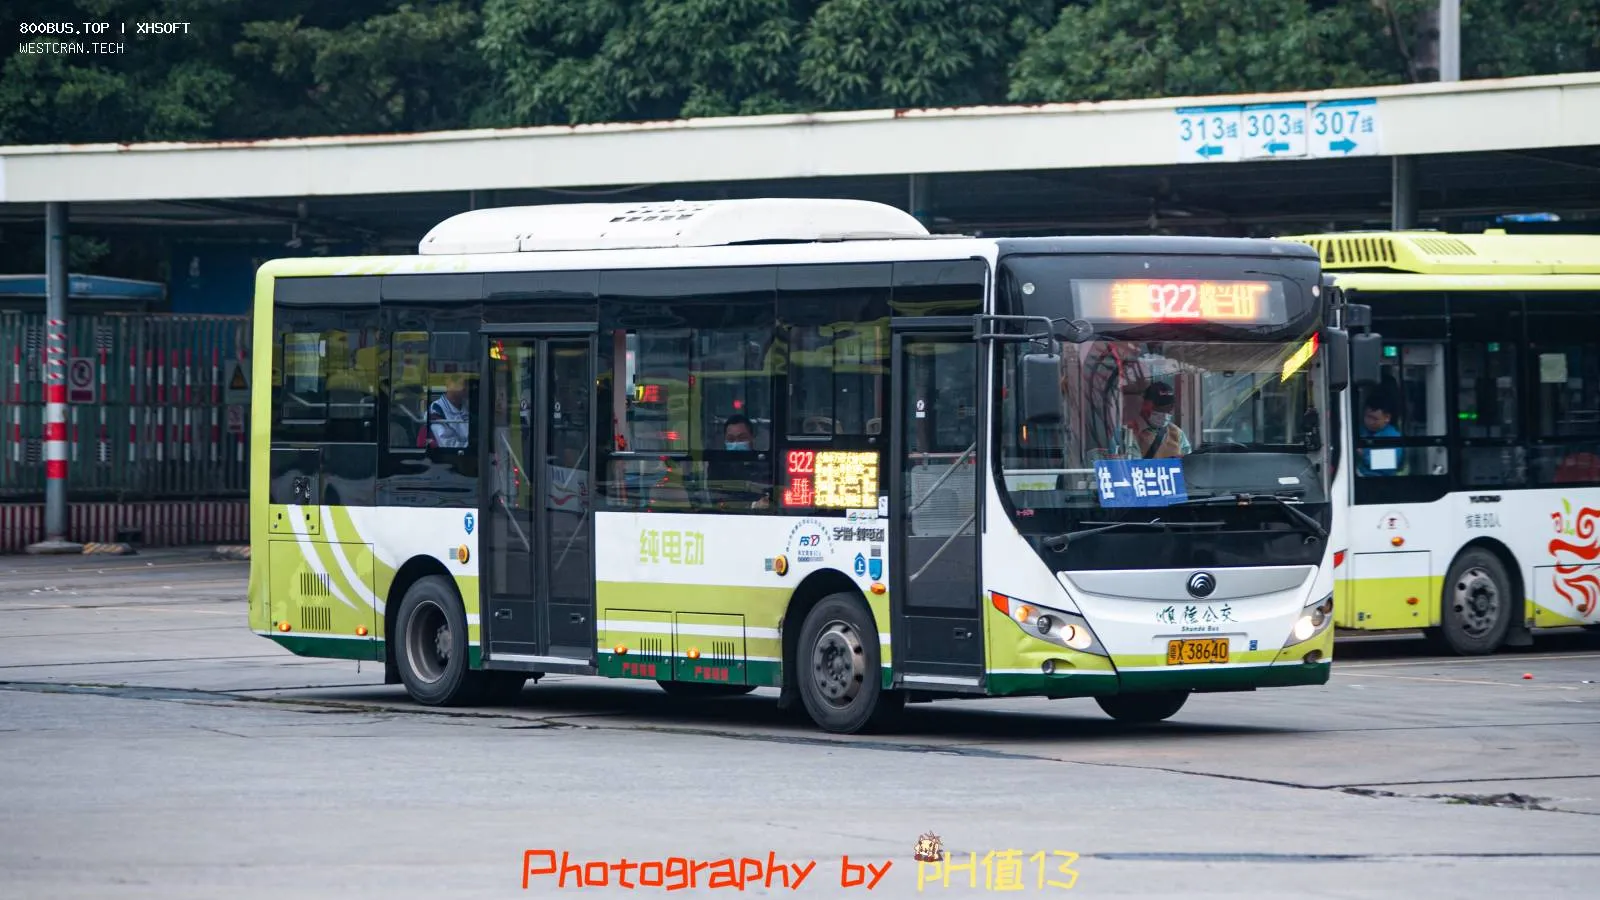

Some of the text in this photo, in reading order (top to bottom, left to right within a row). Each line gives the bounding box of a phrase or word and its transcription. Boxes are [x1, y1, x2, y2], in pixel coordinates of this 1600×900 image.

[1180, 117, 1238, 142] 313线
[1247, 113, 1304, 137] 303线
[1315, 111, 1374, 136] 307线
[1148, 283, 1200, 318] 922
[788, 451, 814, 473] 922
[639, 529, 705, 565] 纯电动
